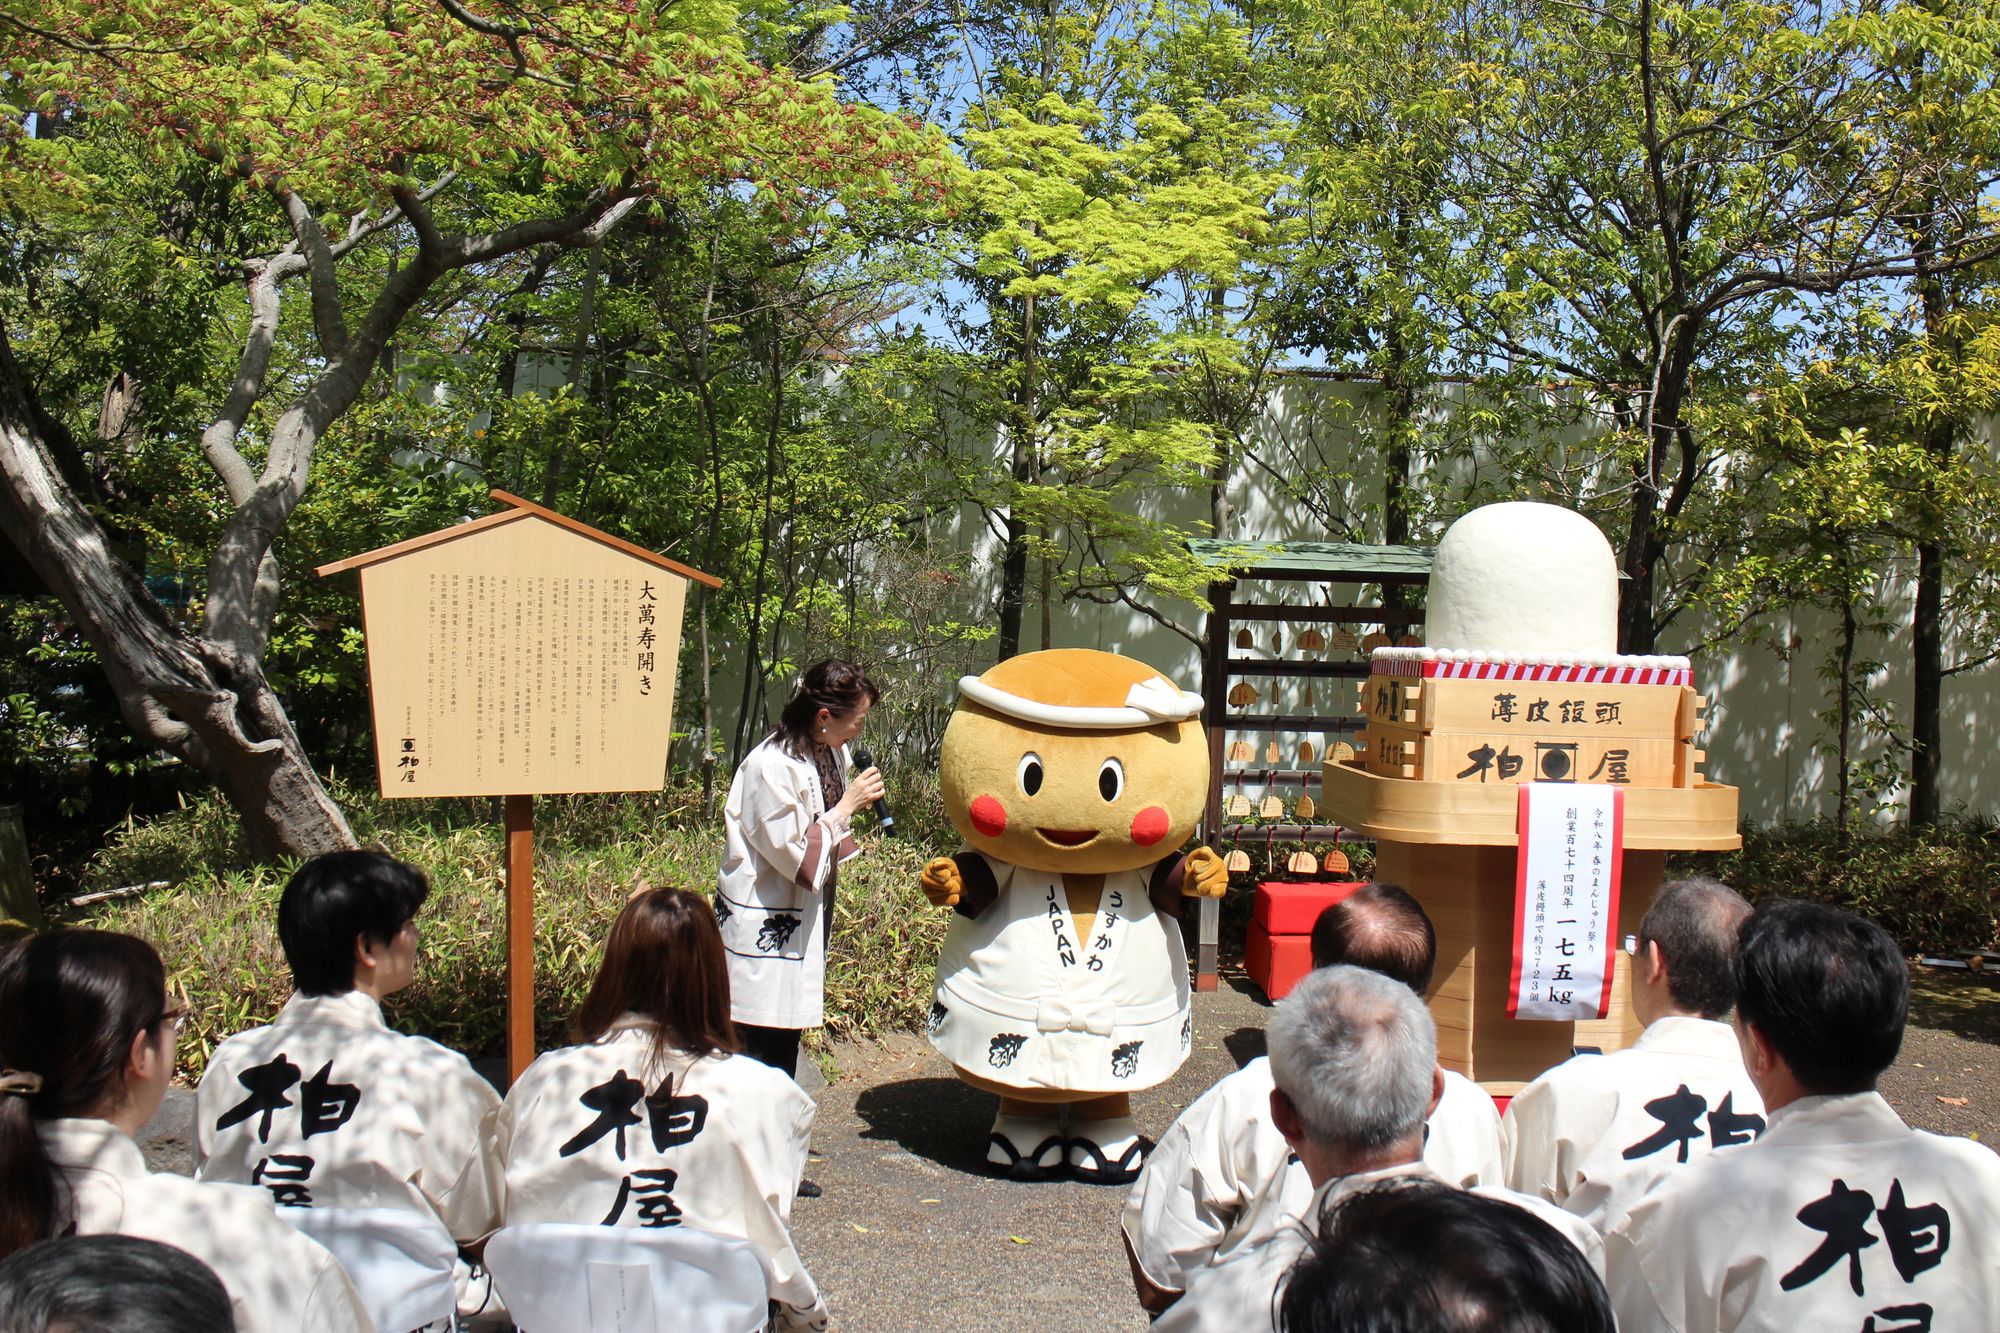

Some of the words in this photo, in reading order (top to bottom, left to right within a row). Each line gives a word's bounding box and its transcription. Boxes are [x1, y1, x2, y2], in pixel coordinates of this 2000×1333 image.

[637, 579, 659, 697] 大萬寿開き
[1491, 693, 1623, 726] 薄皮饅頭
[397, 755, 420, 783] 柏屋
[1562, 807, 1577, 910] 創業百七十四周年
[1587, 807, 1604, 954] 令和八年春のまんじゅう祭り
[1046, 884, 1076, 968] JAPAN
[1086, 890, 1123, 973] うすかわ
[215, 1052, 362, 1208] 柏屋
[558, 1068, 709, 1229] 柏屋
[1621, 1083, 1767, 1164] 柏
